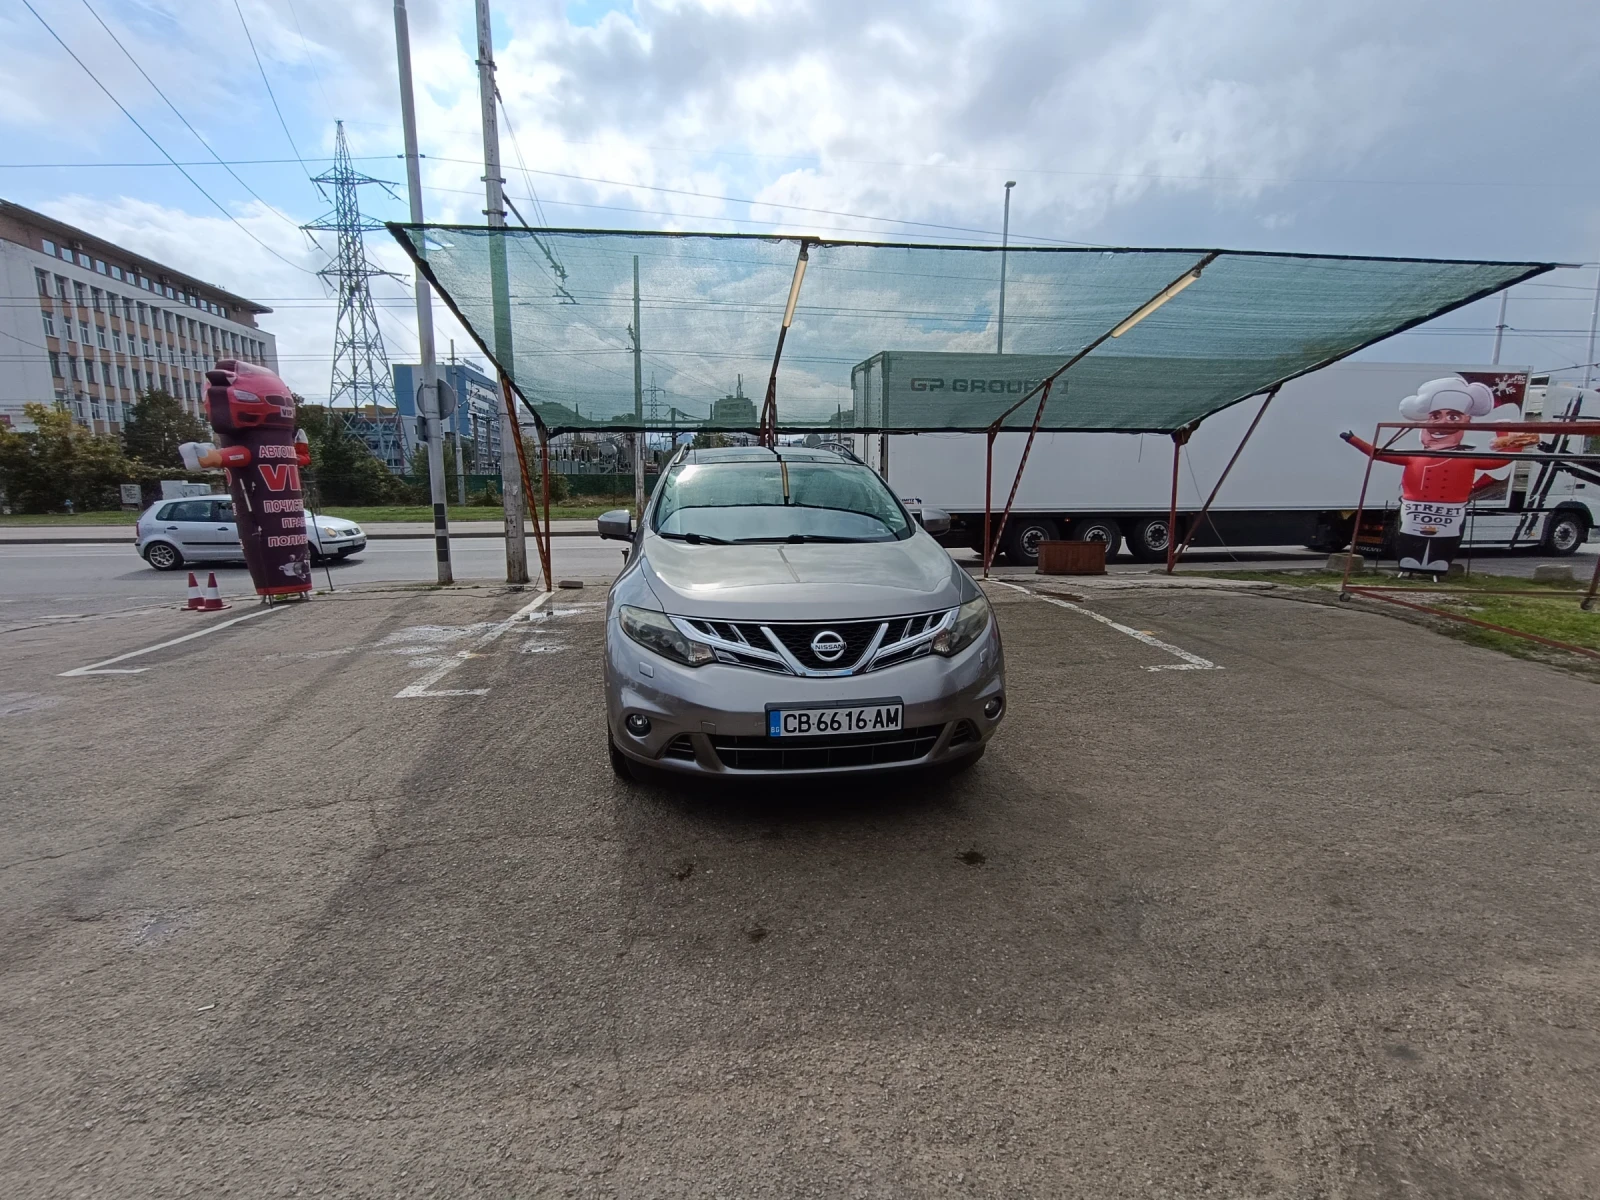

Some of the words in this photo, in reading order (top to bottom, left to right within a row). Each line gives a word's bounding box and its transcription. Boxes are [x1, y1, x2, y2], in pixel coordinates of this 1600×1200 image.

[910, 377, 944, 392] GP
[1405, 502, 1461, 516] STREET
[1413, 514, 1453, 525] FOOD
